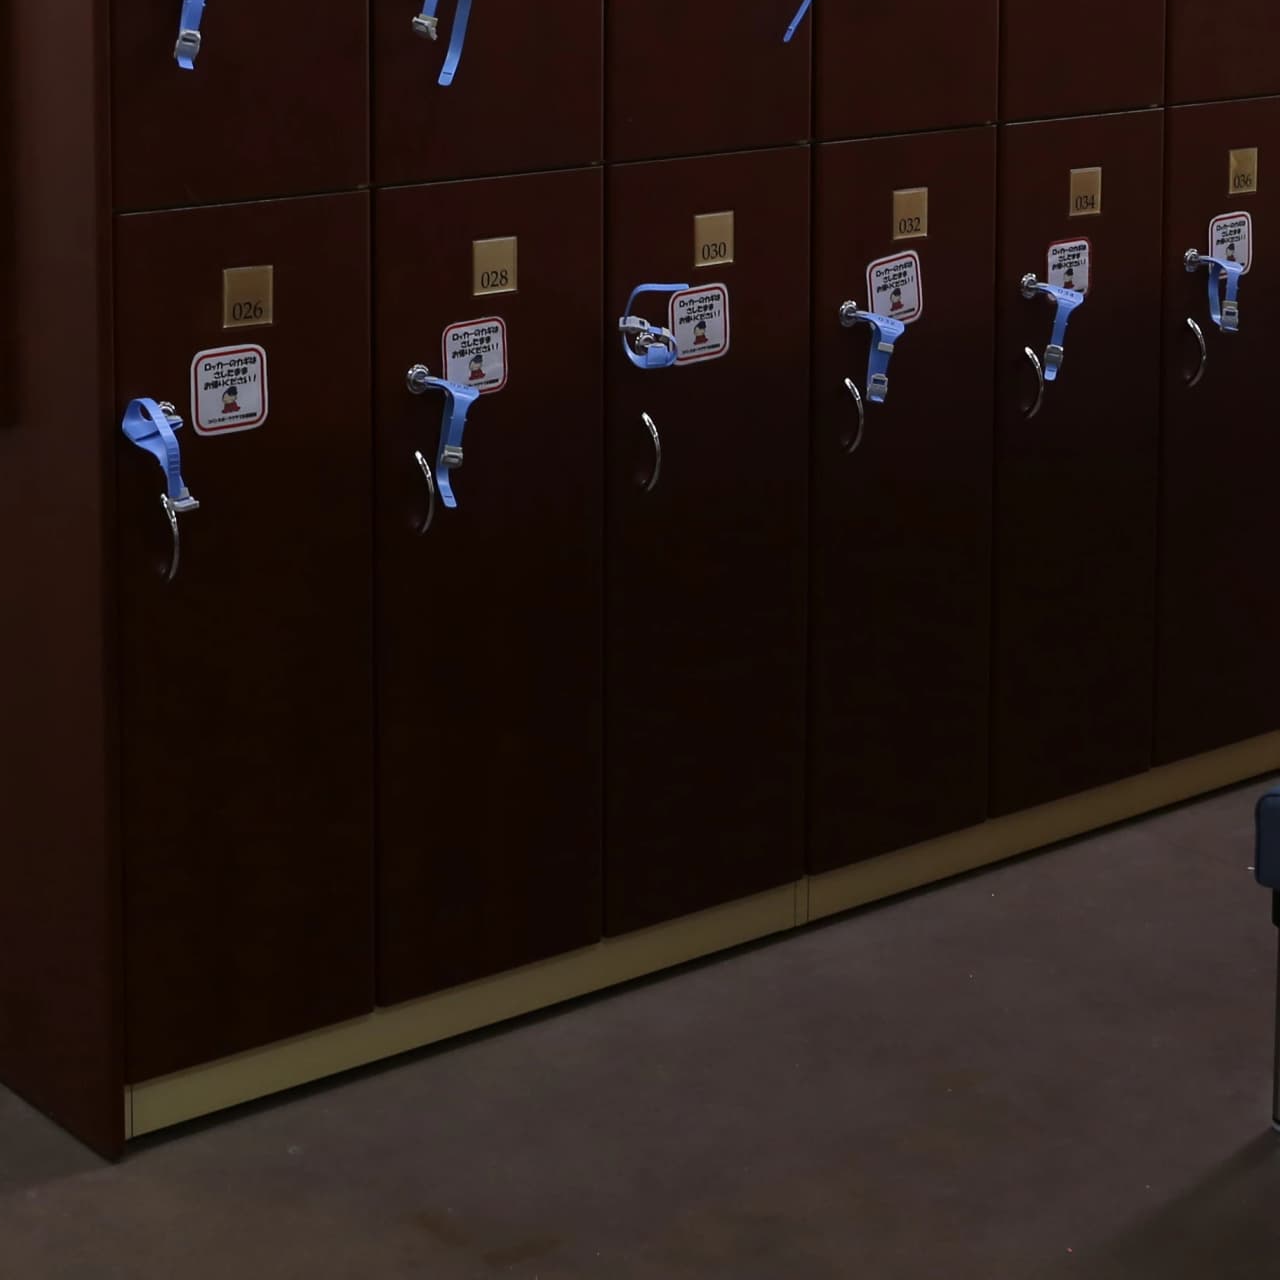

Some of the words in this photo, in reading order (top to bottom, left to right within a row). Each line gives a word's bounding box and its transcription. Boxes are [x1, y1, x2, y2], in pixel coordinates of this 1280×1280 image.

[1233, 174, 1252, 188] 036
[1075, 195, 1096, 211] 034
[899, 217, 921, 233] 032
[702, 242, 727, 259] 030
[481, 270, 508, 288] 028
[232, 301, 263, 321] 026
[213, 367, 248, 379] さしたまま
